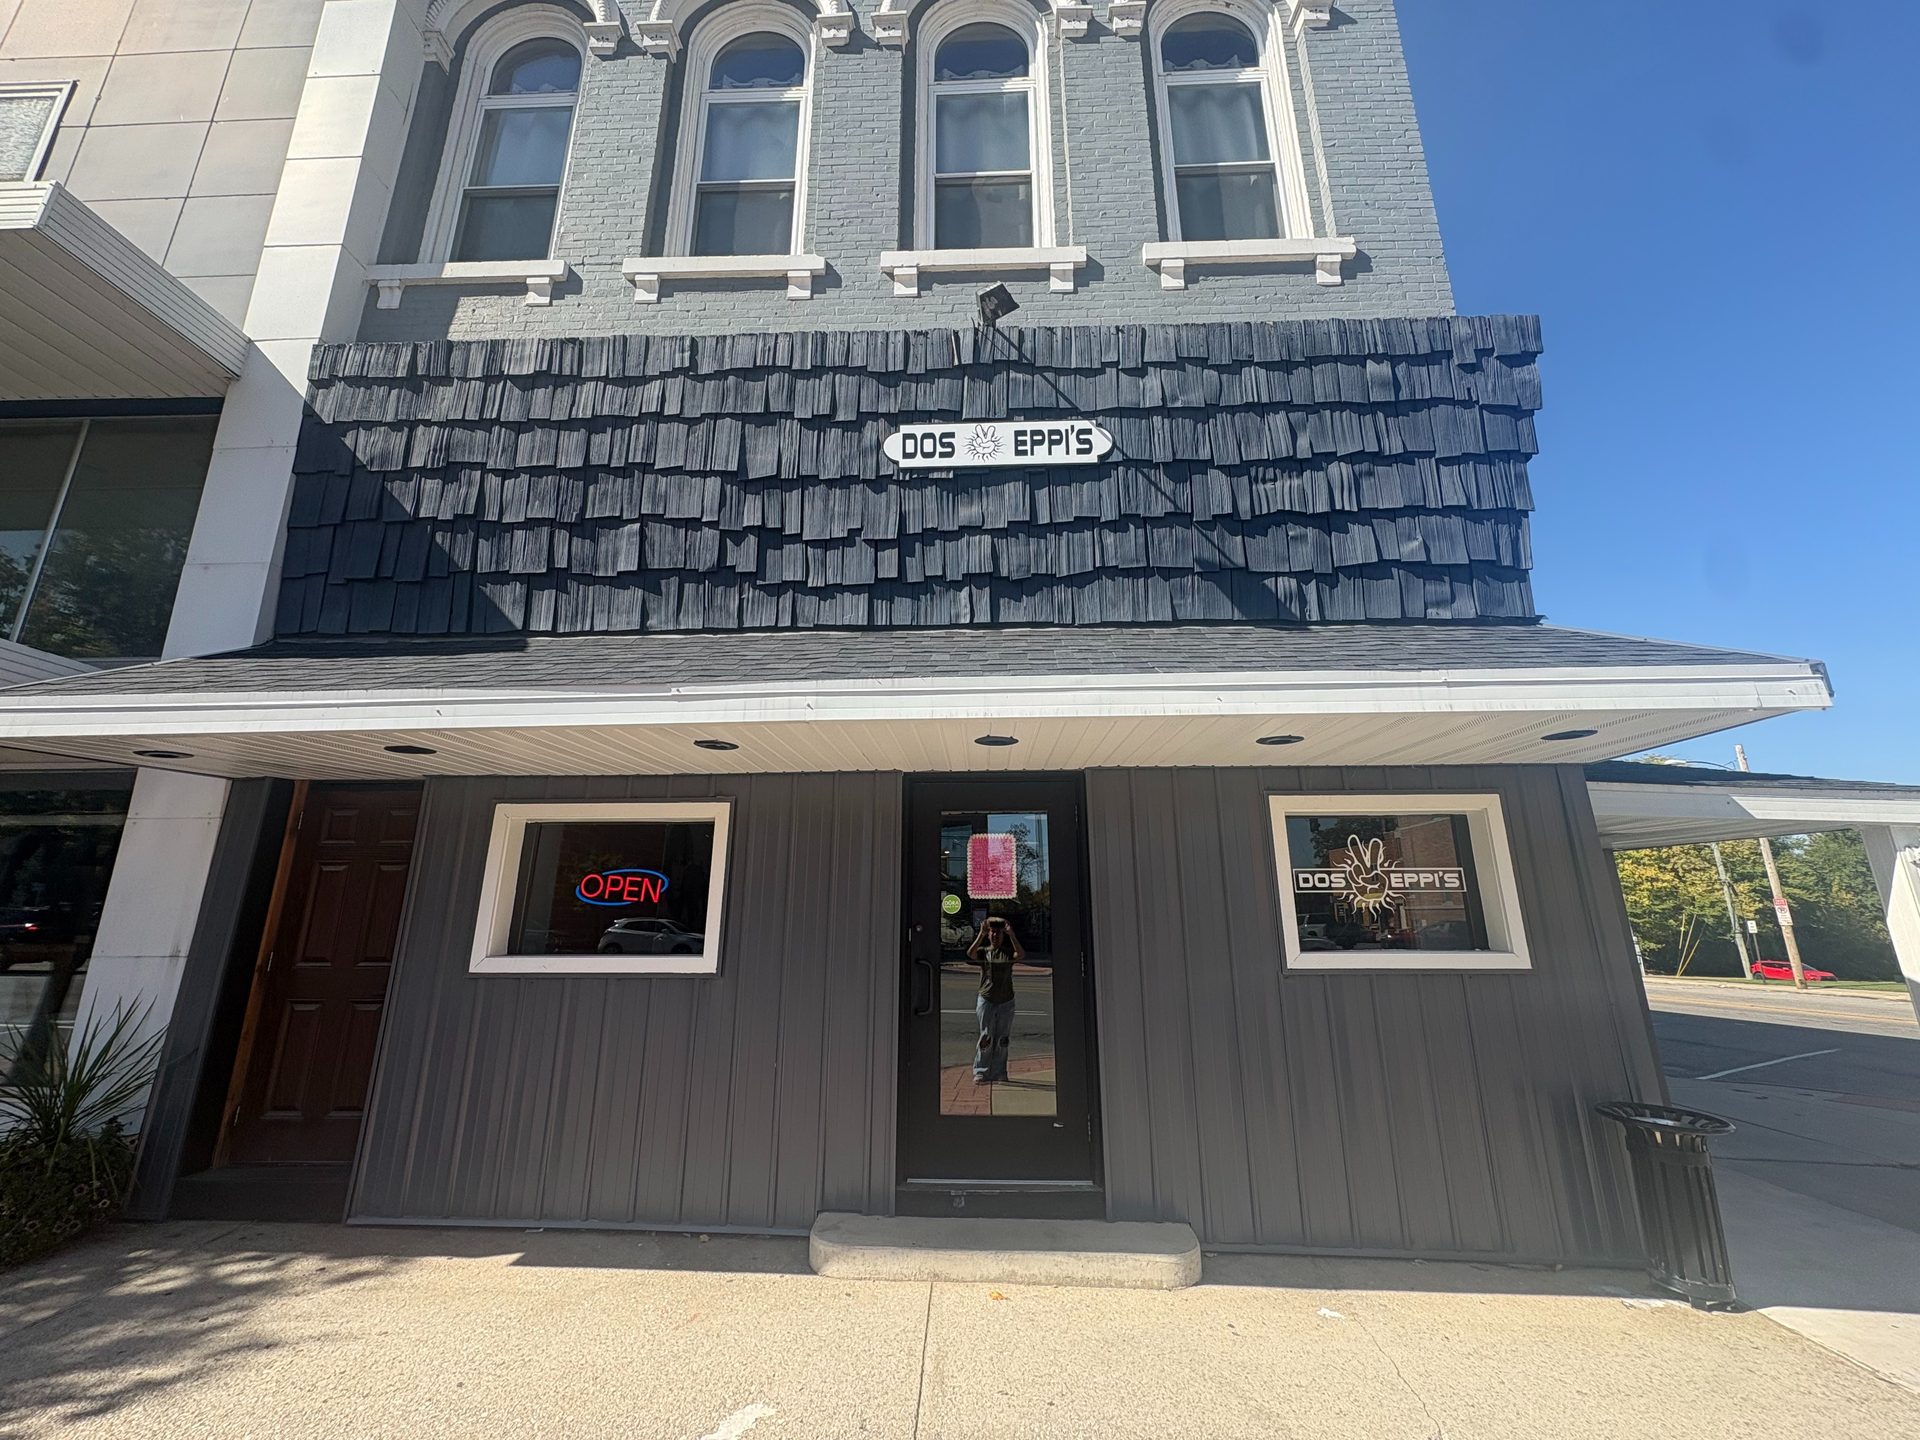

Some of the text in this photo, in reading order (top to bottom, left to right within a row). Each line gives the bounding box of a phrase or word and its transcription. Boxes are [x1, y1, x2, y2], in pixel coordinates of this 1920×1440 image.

[902, 425, 1093, 460] DOS EPPI'S
[580, 873, 662, 903] OPEN
[1298, 871, 1460, 888] DOS EPPI'S
